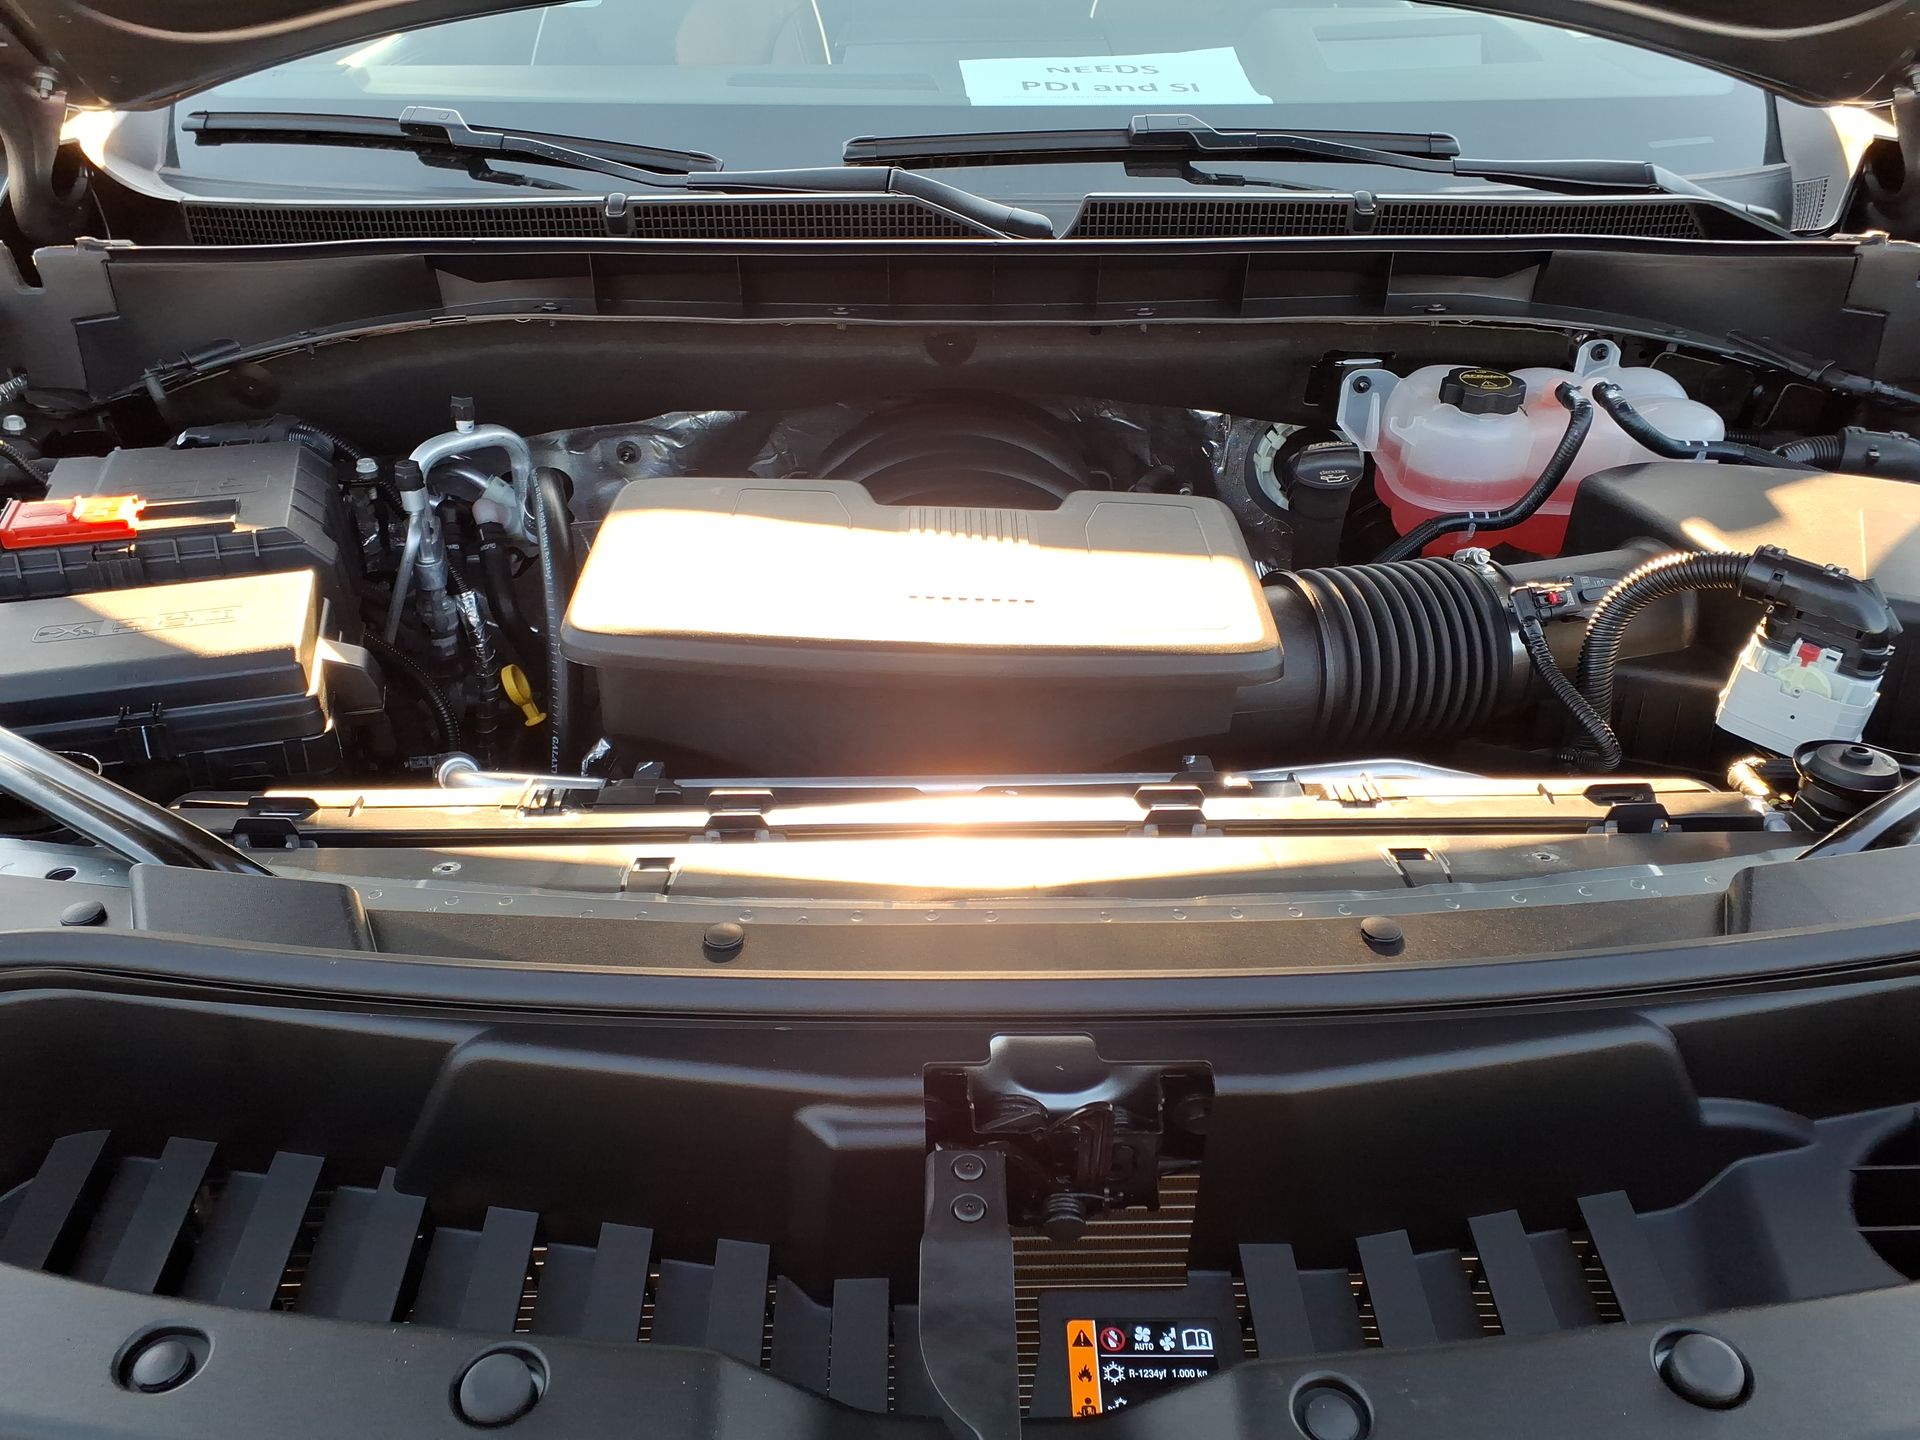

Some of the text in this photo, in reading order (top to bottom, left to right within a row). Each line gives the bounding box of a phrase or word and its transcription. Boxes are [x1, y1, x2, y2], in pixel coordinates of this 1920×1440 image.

[1046, 64, 1160, 75] NEEDS
[1021, 80, 1200, 93] PDI and SI
[1134, 1342, 1154, 1351] AUTO
[1129, 1368, 1167, 1380] R-1234yf
[1171, 1369, 1195, 1378] 1.000
